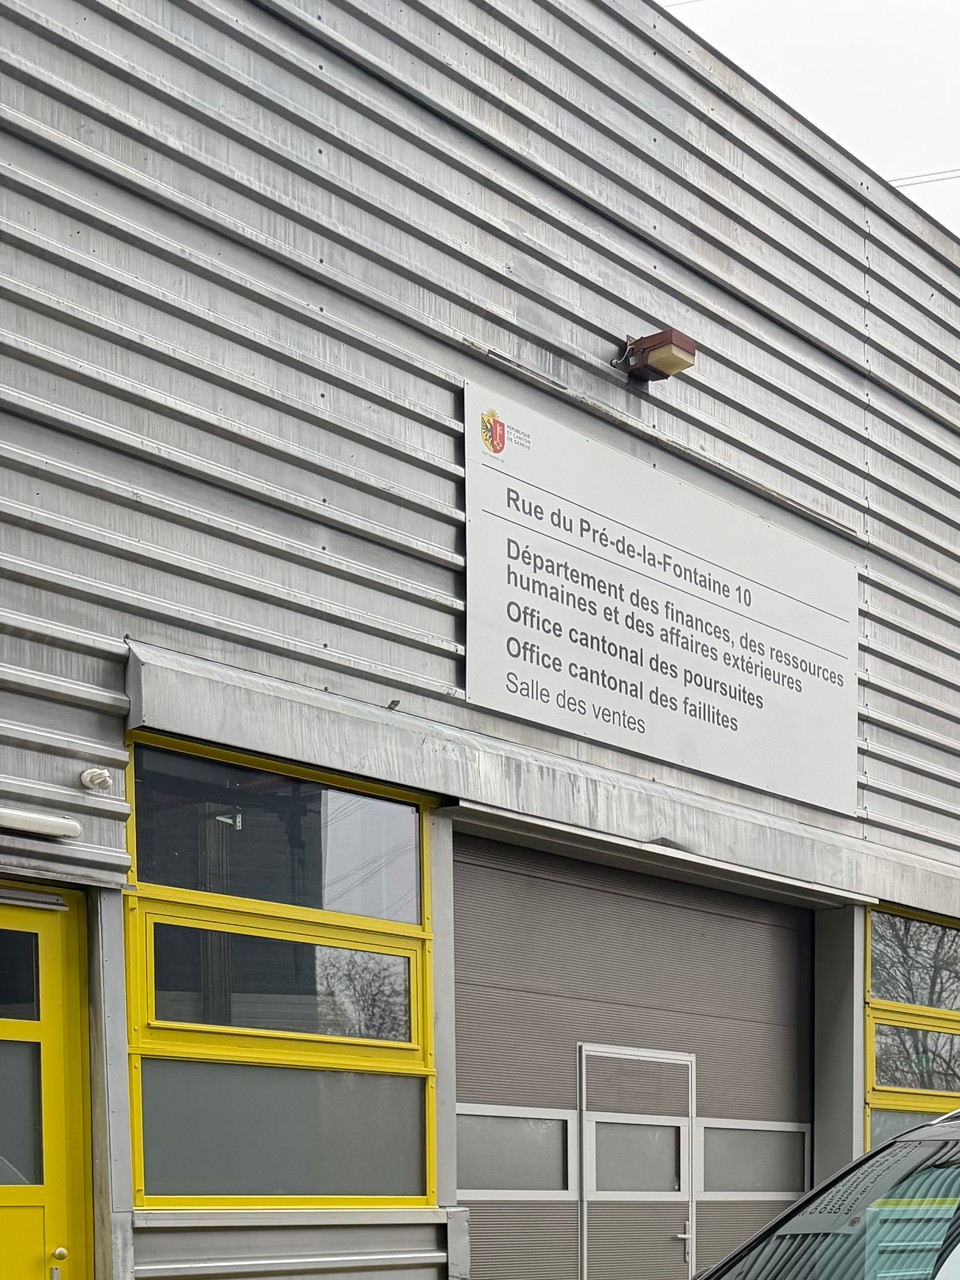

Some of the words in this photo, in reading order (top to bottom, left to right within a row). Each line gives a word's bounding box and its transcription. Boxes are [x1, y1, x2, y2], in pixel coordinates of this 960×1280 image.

[507, 487, 544, 520] Rue
[551, 508, 573, 533] du
[580, 518, 730, 598] Pré-de-la-Fontaine
[736, 586, 751, 607] 10
[507, 538, 624, 602] Département
[630, 589, 659, 615] des
[664, 601, 734, 648] finances,
[740, 632, 765, 656] des
[770, 647, 844, 687] ressources
[507, 564, 597, 616] humaines
[603, 606, 619, 625] et
[625, 611, 654, 637] des
[660, 626, 718, 661] affaires
[723, 652, 802, 693] extérieures
[507, 601, 562, 638] Office
[569, 628, 643, 667] cantonal
[649, 653, 678, 679] des
[684, 669, 763, 709] poursuites
[506, 637, 562, 672] Office
[569, 662, 643, 700] cantonal
[649, 686, 678, 711] des
[683, 696, 738, 731] faillites
[506, 672, 550, 703] Salle
[556, 689, 586, 715] des
[592, 704, 645, 734] ventes
